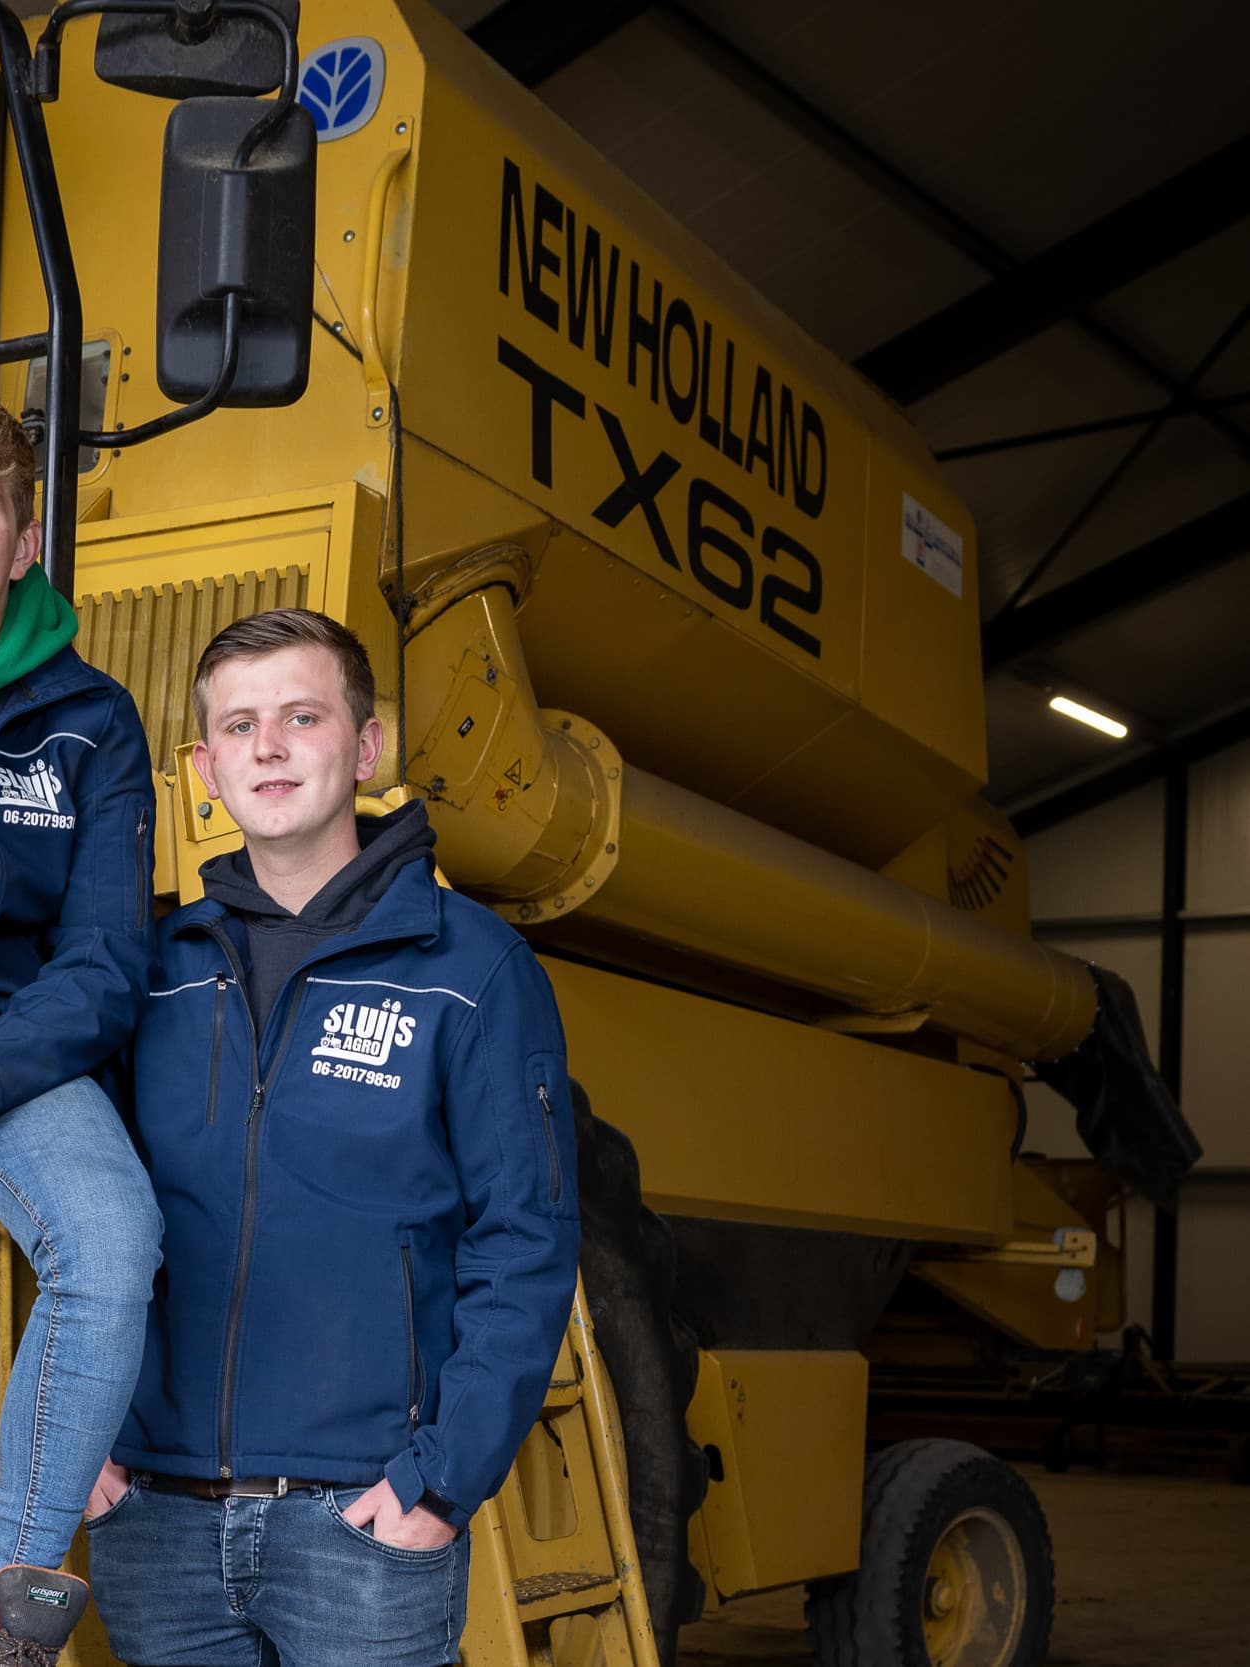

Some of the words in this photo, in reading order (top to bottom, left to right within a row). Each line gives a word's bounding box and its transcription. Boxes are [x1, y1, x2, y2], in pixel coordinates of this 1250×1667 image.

[499, 156, 620, 369] NEW
[628, 259, 826, 519] HOLLAND
[498, 335, 822, 659] TX62
[3, 809, 76, 829] 06-2017983
[342, 1036, 381, 1056] AGRO
[312, 1060, 401, 1089] 06-20179830
